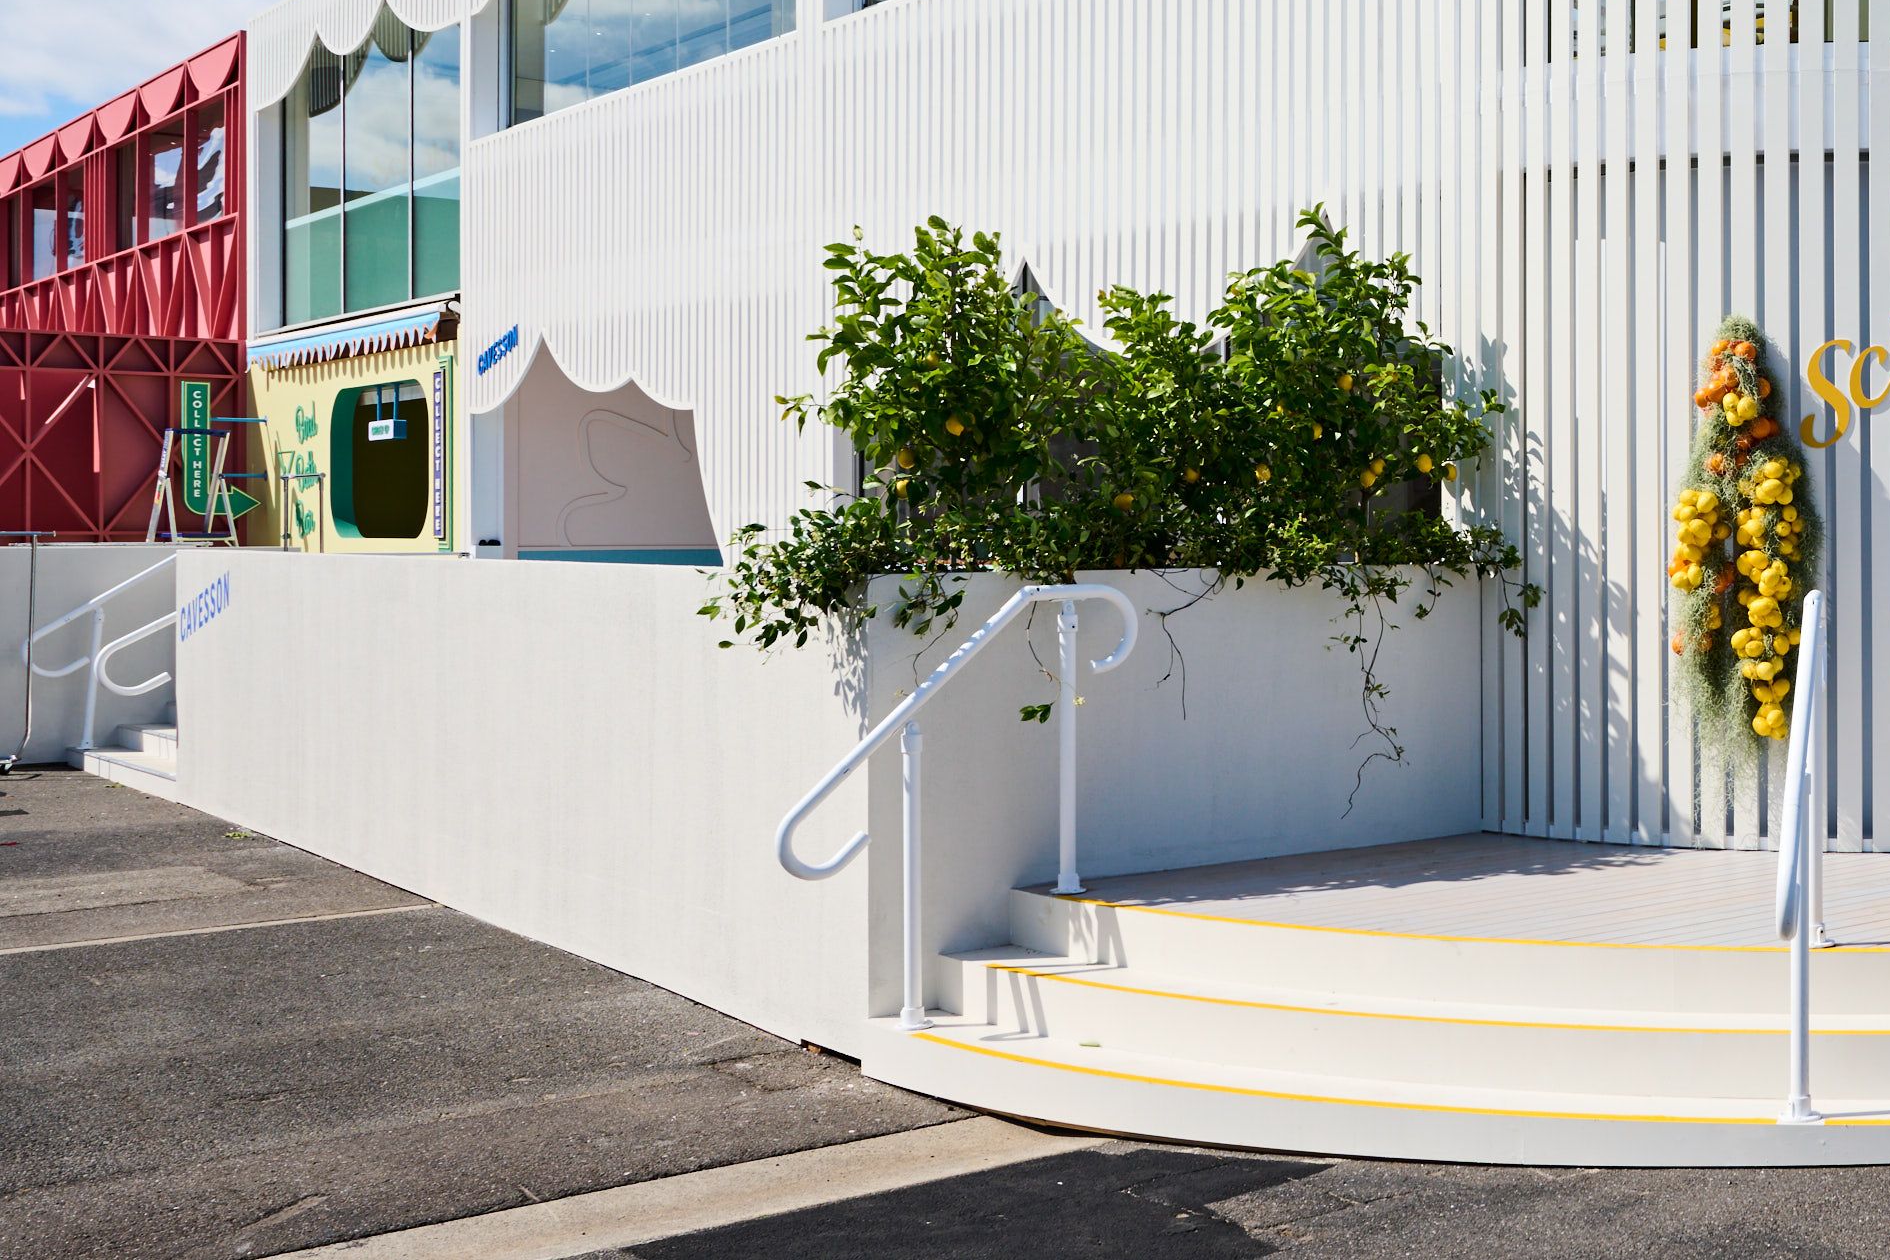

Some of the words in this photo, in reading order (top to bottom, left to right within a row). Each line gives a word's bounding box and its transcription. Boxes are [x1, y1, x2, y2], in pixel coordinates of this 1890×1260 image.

[478, 323, 519, 376] CAVESSON
[192, 390, 203, 456] COLLCT
[192, 460, 202, 498] HERE
[180, 569, 230, 643] CAVESSON
